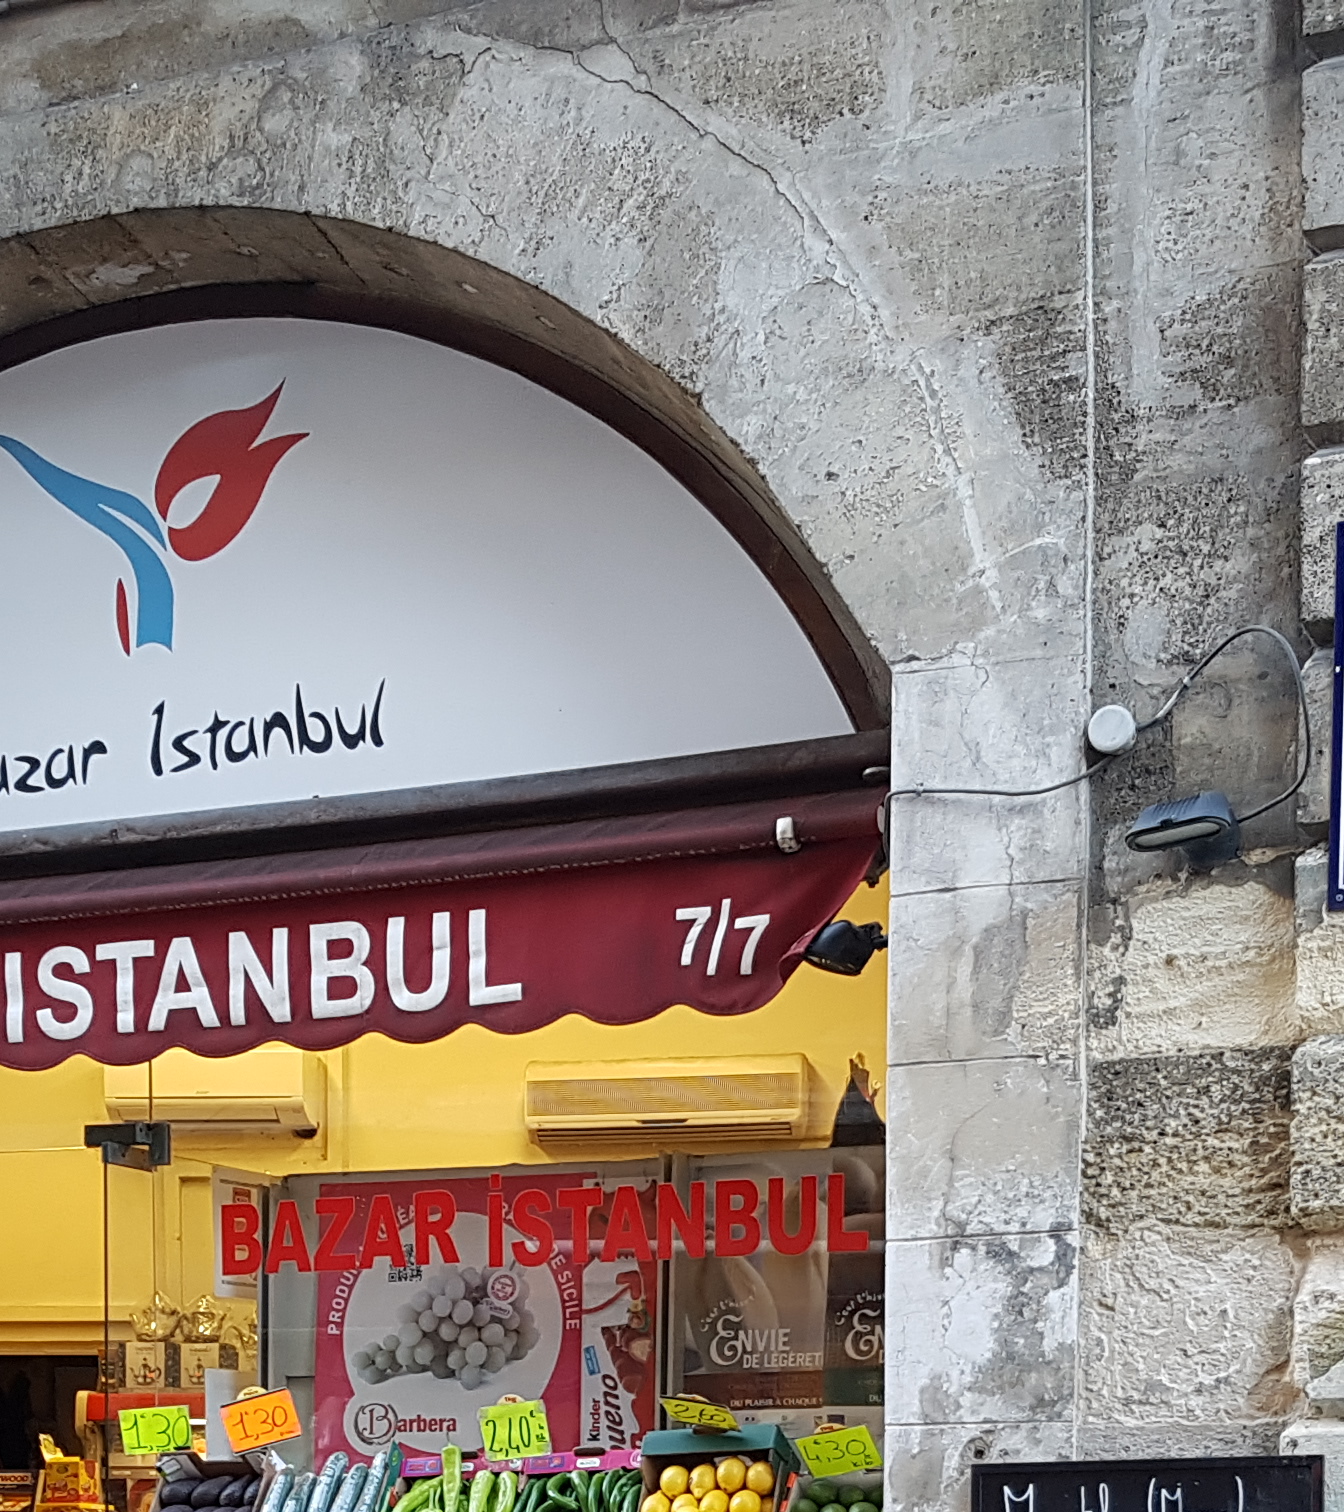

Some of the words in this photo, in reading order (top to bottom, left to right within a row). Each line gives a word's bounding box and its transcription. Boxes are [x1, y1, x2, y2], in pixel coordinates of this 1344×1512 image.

[150, 677, 385, 776] Istanbul
[4, 907, 523, 1043] ISTANBUL
[675, 897, 769, 977] 7/7
[221, 1189, 460, 1276] BAZAR
[557, 1270, 580, 1330] SICILE
[355, 1404, 456, 1444] Barbera
